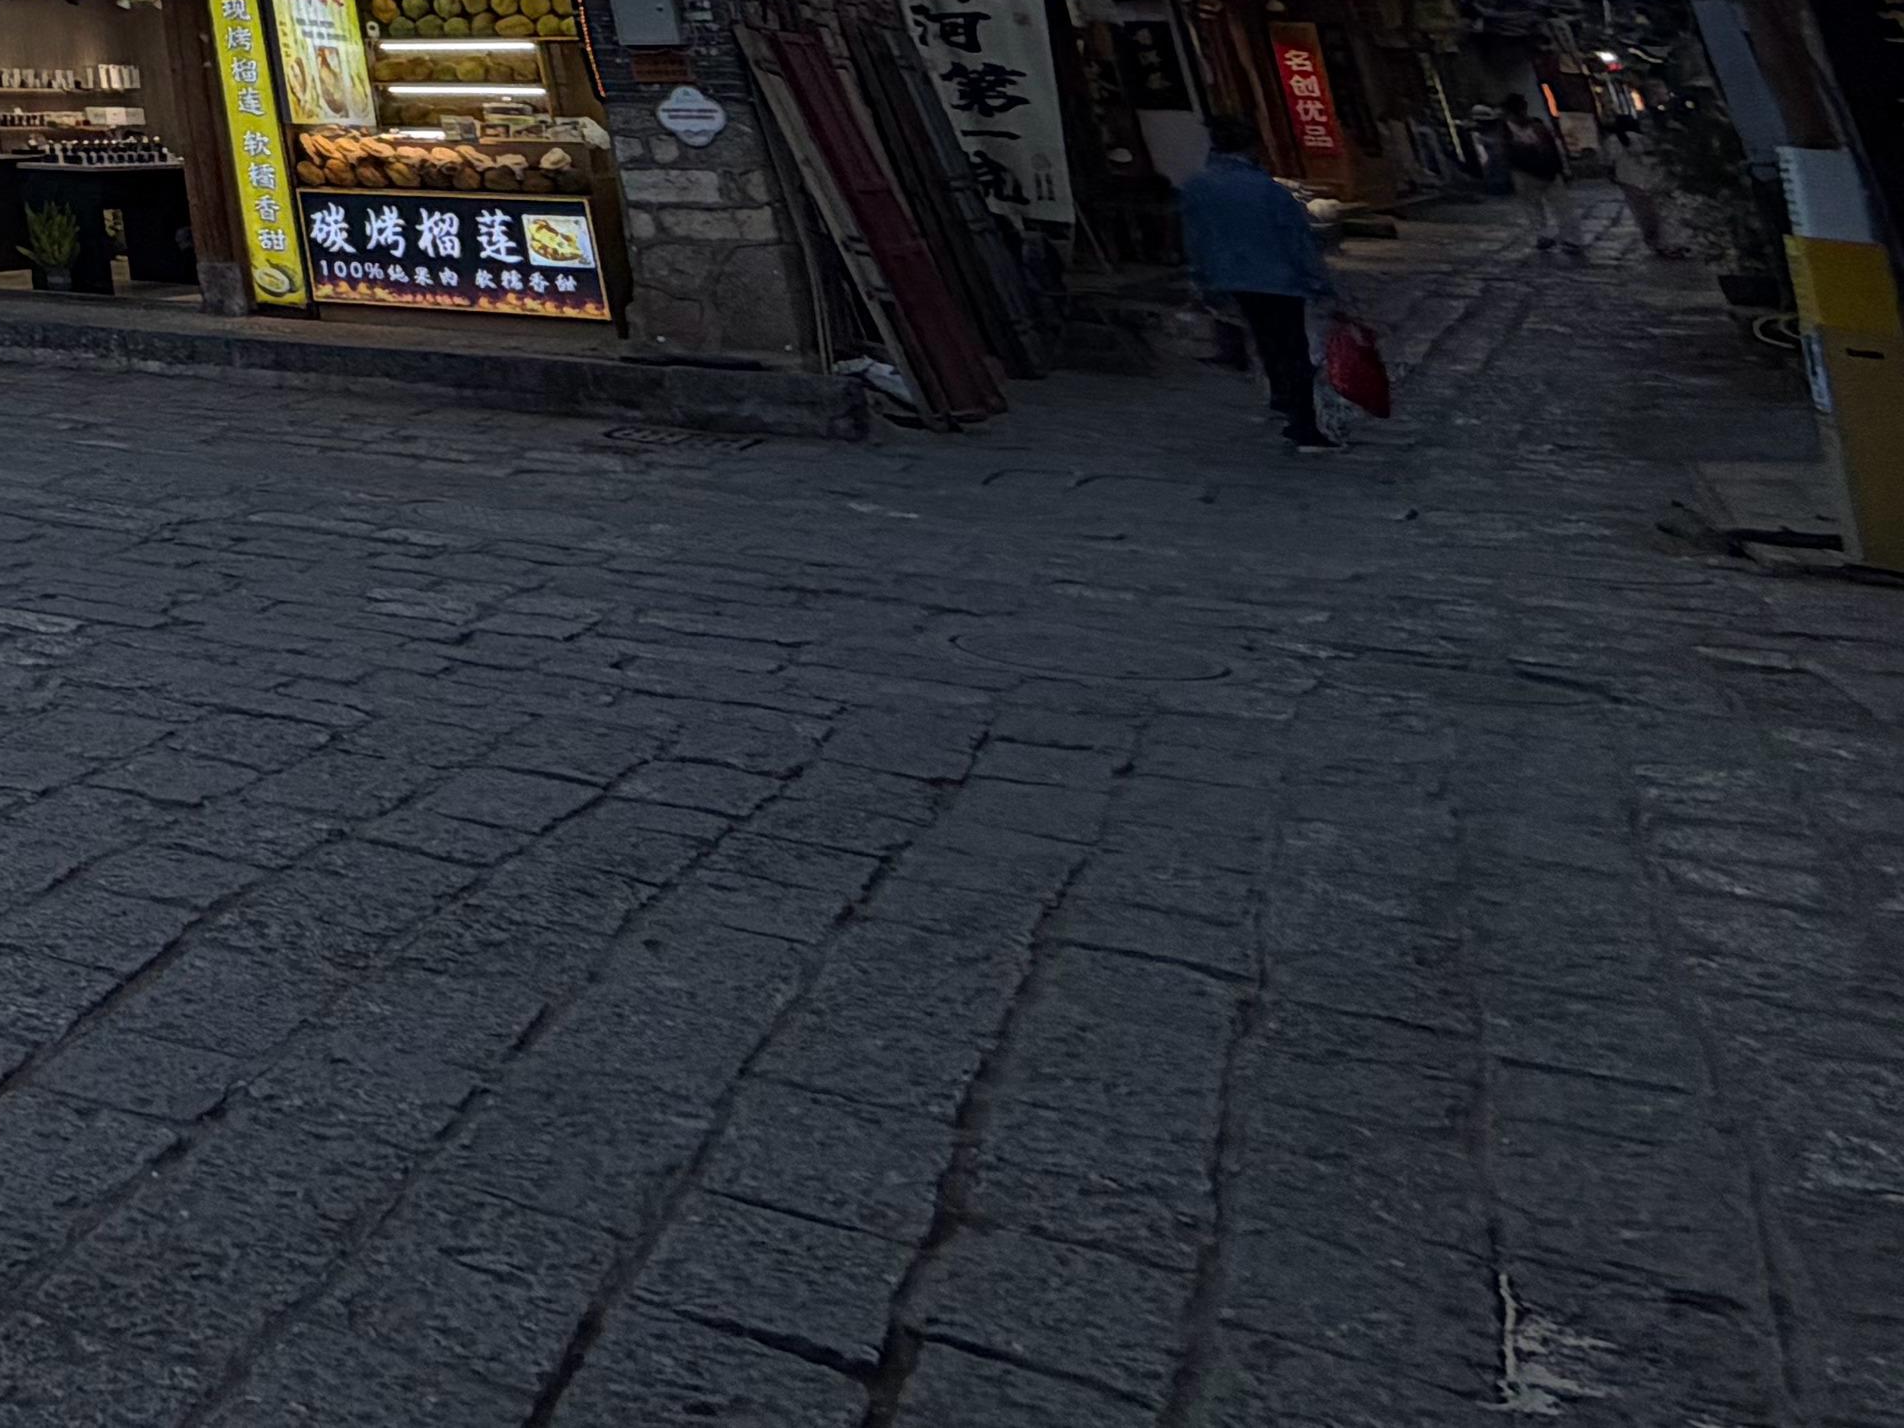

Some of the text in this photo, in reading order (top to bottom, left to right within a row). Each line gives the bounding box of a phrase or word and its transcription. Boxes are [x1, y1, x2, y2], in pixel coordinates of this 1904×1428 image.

[1283, 49, 1335, 148] 名创优品
[242, 129, 288, 253] 软糯香甜
[309, 201, 525, 263] 碳烤榴莲
[319, 259, 579, 293] 100%纯果肉 软糯香甜
